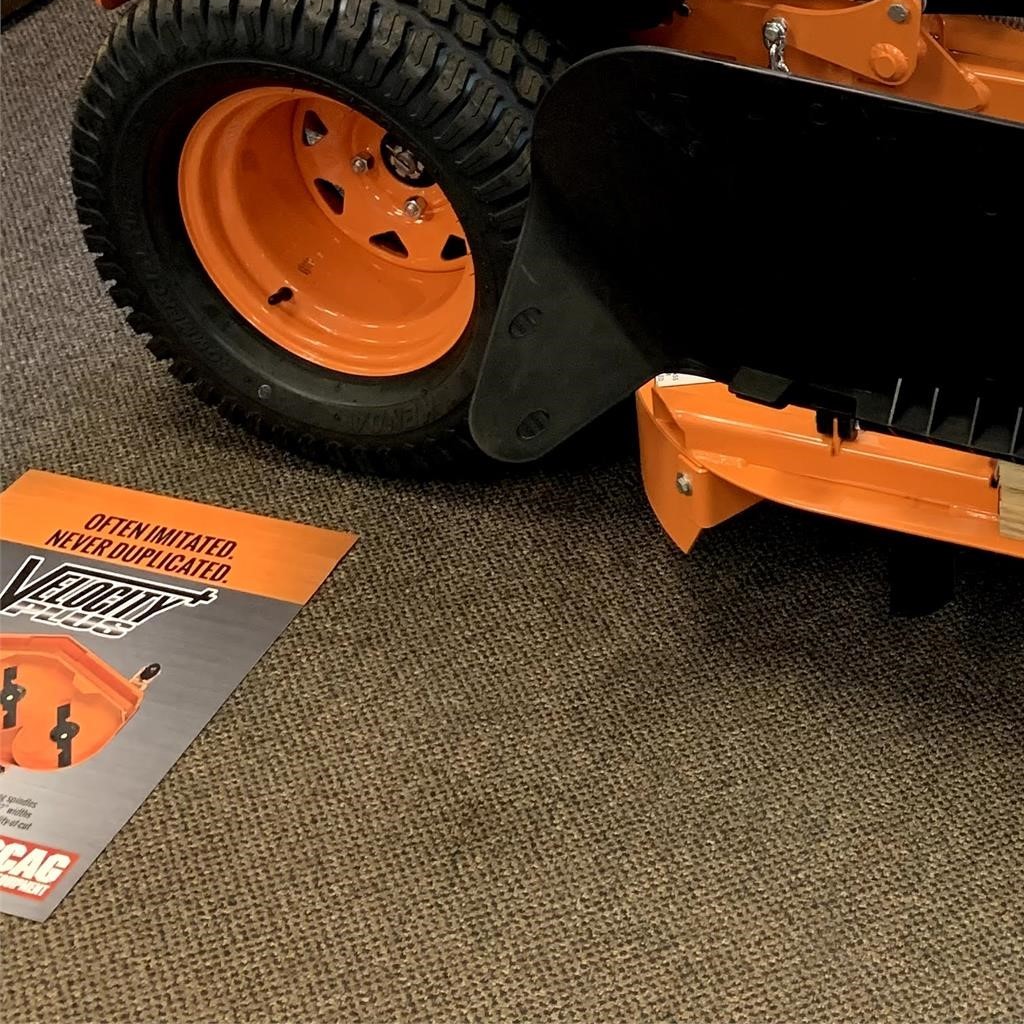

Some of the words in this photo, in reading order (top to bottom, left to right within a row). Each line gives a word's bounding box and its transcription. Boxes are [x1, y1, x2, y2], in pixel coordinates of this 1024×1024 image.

[45, 529, 114, 557] NEVER
[107, 544, 232, 584] DUPLICATED.
[84, 513, 151, 539] OFTEN
[144, 525, 237, 560] IMITATED.
[0, 555, 195, 625] VELOCITY
[4, 600, 138, 638] PLUS
